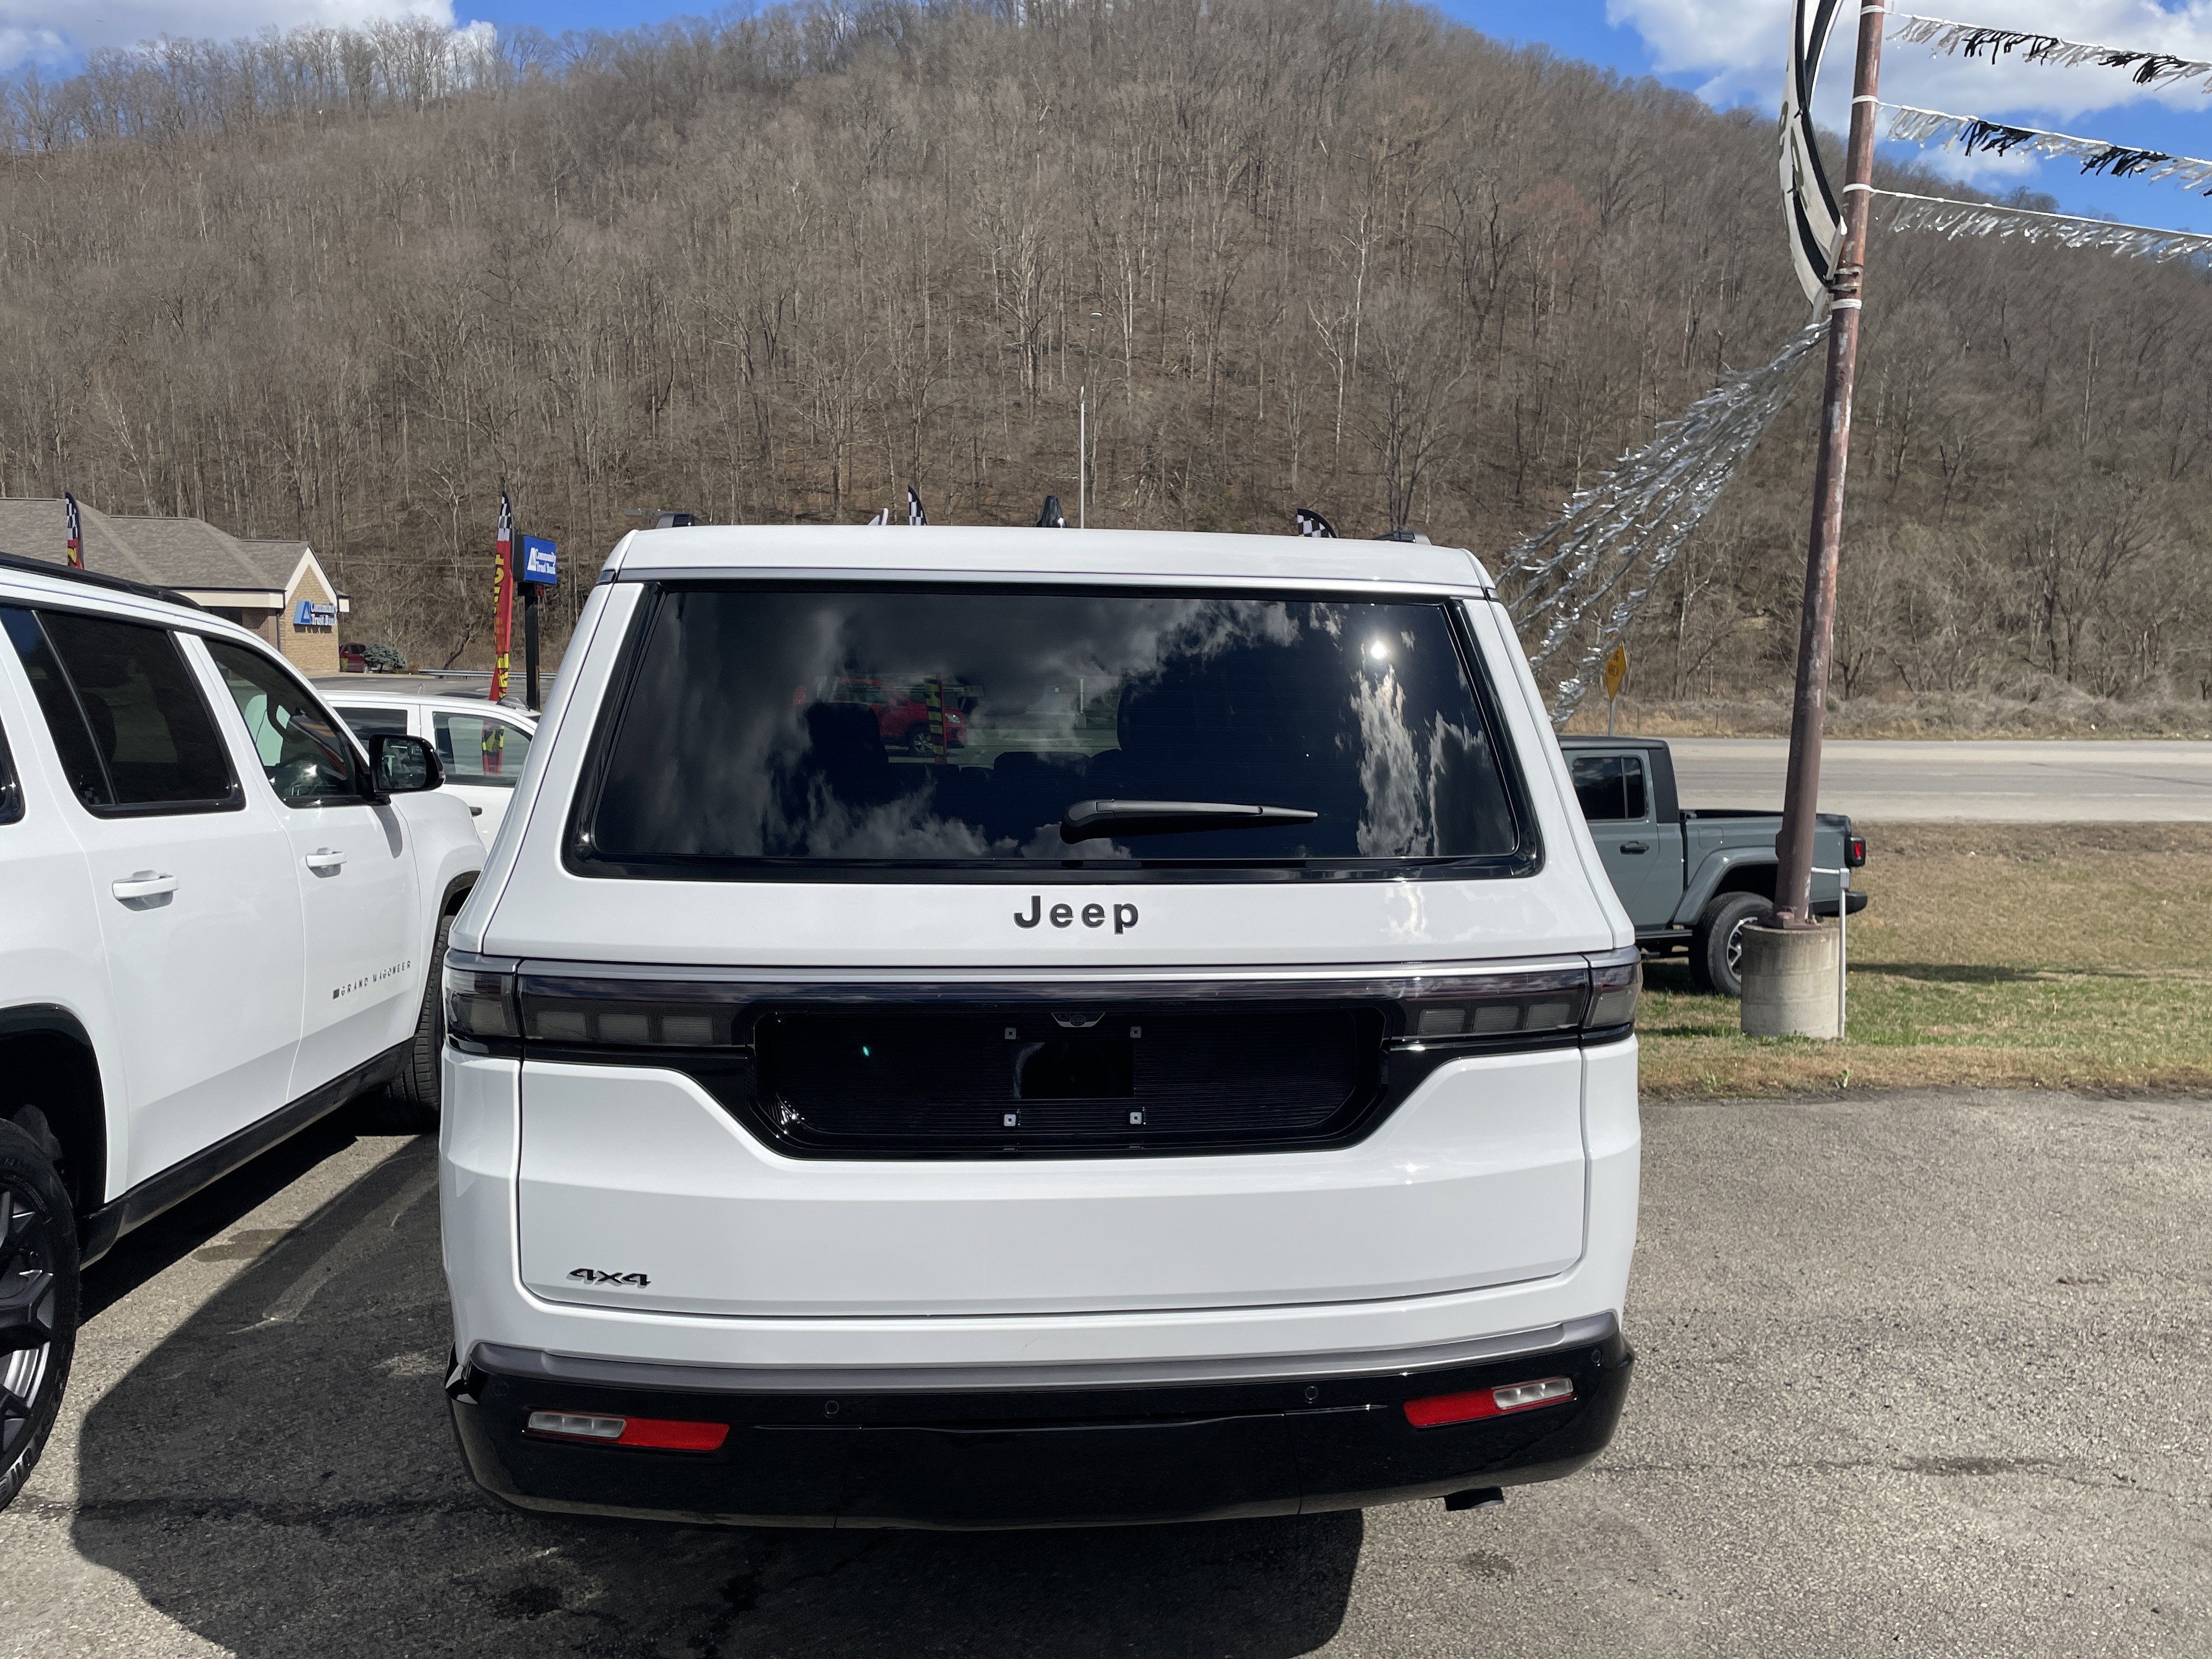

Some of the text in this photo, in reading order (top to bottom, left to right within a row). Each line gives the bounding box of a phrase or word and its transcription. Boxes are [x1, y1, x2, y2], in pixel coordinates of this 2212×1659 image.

[535, 561, 547, 573] Trust
[311, 614, 324, 625] Trust
[1014, 895, 1138, 934] Jeep
[341, 961, 411, 996] GRAND WAGONEER
[569, 1268, 651, 1286] 4x4
